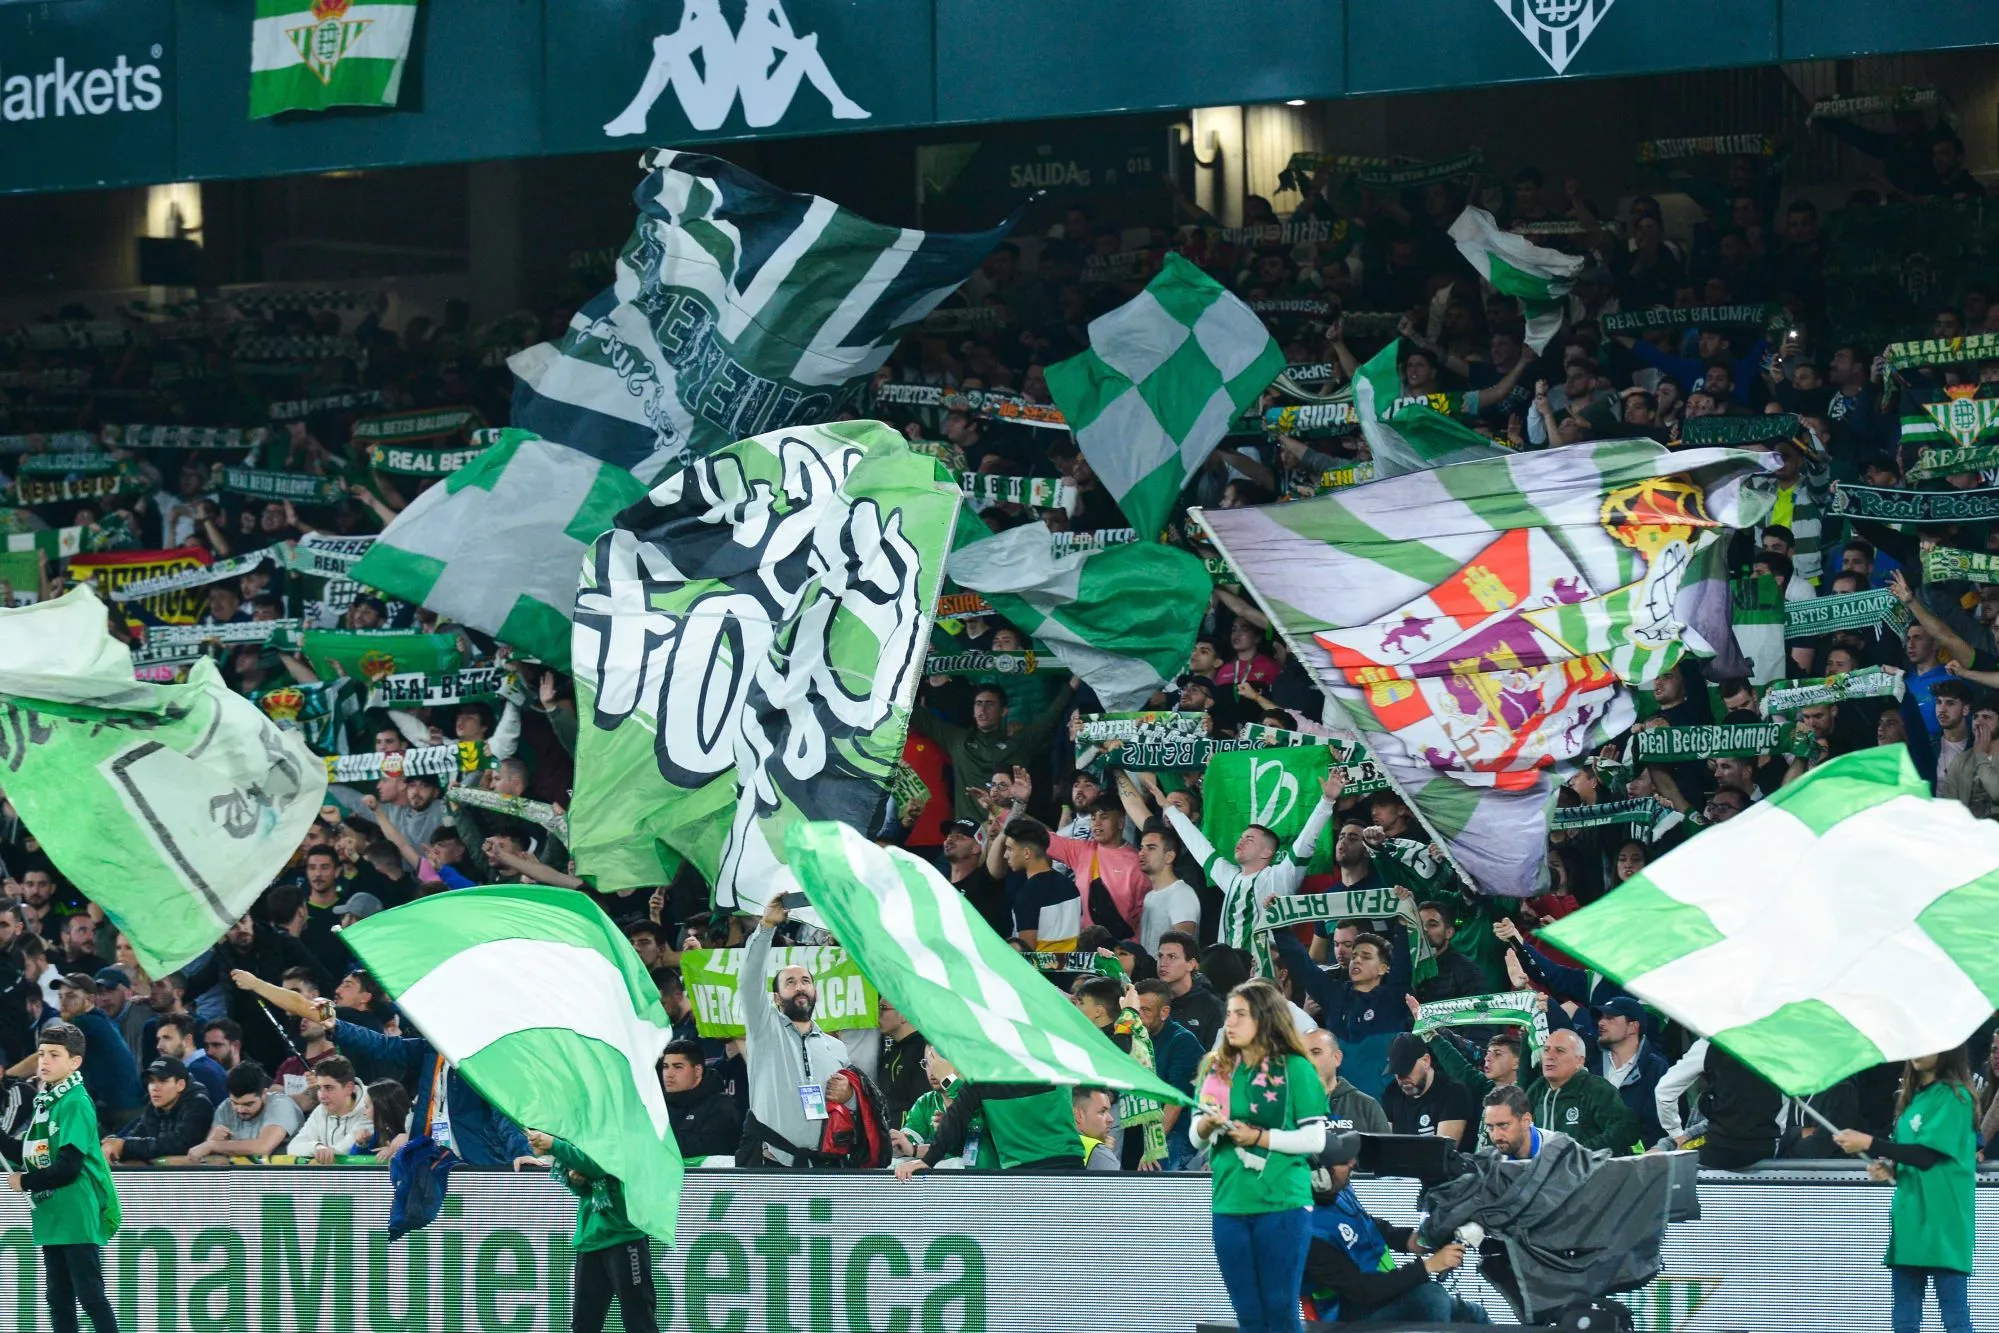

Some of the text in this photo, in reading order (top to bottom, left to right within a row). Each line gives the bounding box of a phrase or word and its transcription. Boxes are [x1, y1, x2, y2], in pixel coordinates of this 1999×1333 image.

[0, 54, 163, 122] arkets
[388, 449, 436, 473] REAL
[1789, 606, 1830, 626] BETIS
[382, 667, 502, 701] REAL BETIS
[1638, 730, 1669, 755] Real
[1672, 726, 1710, 754] Betis
[627, 1245, 642, 1286] Joma
